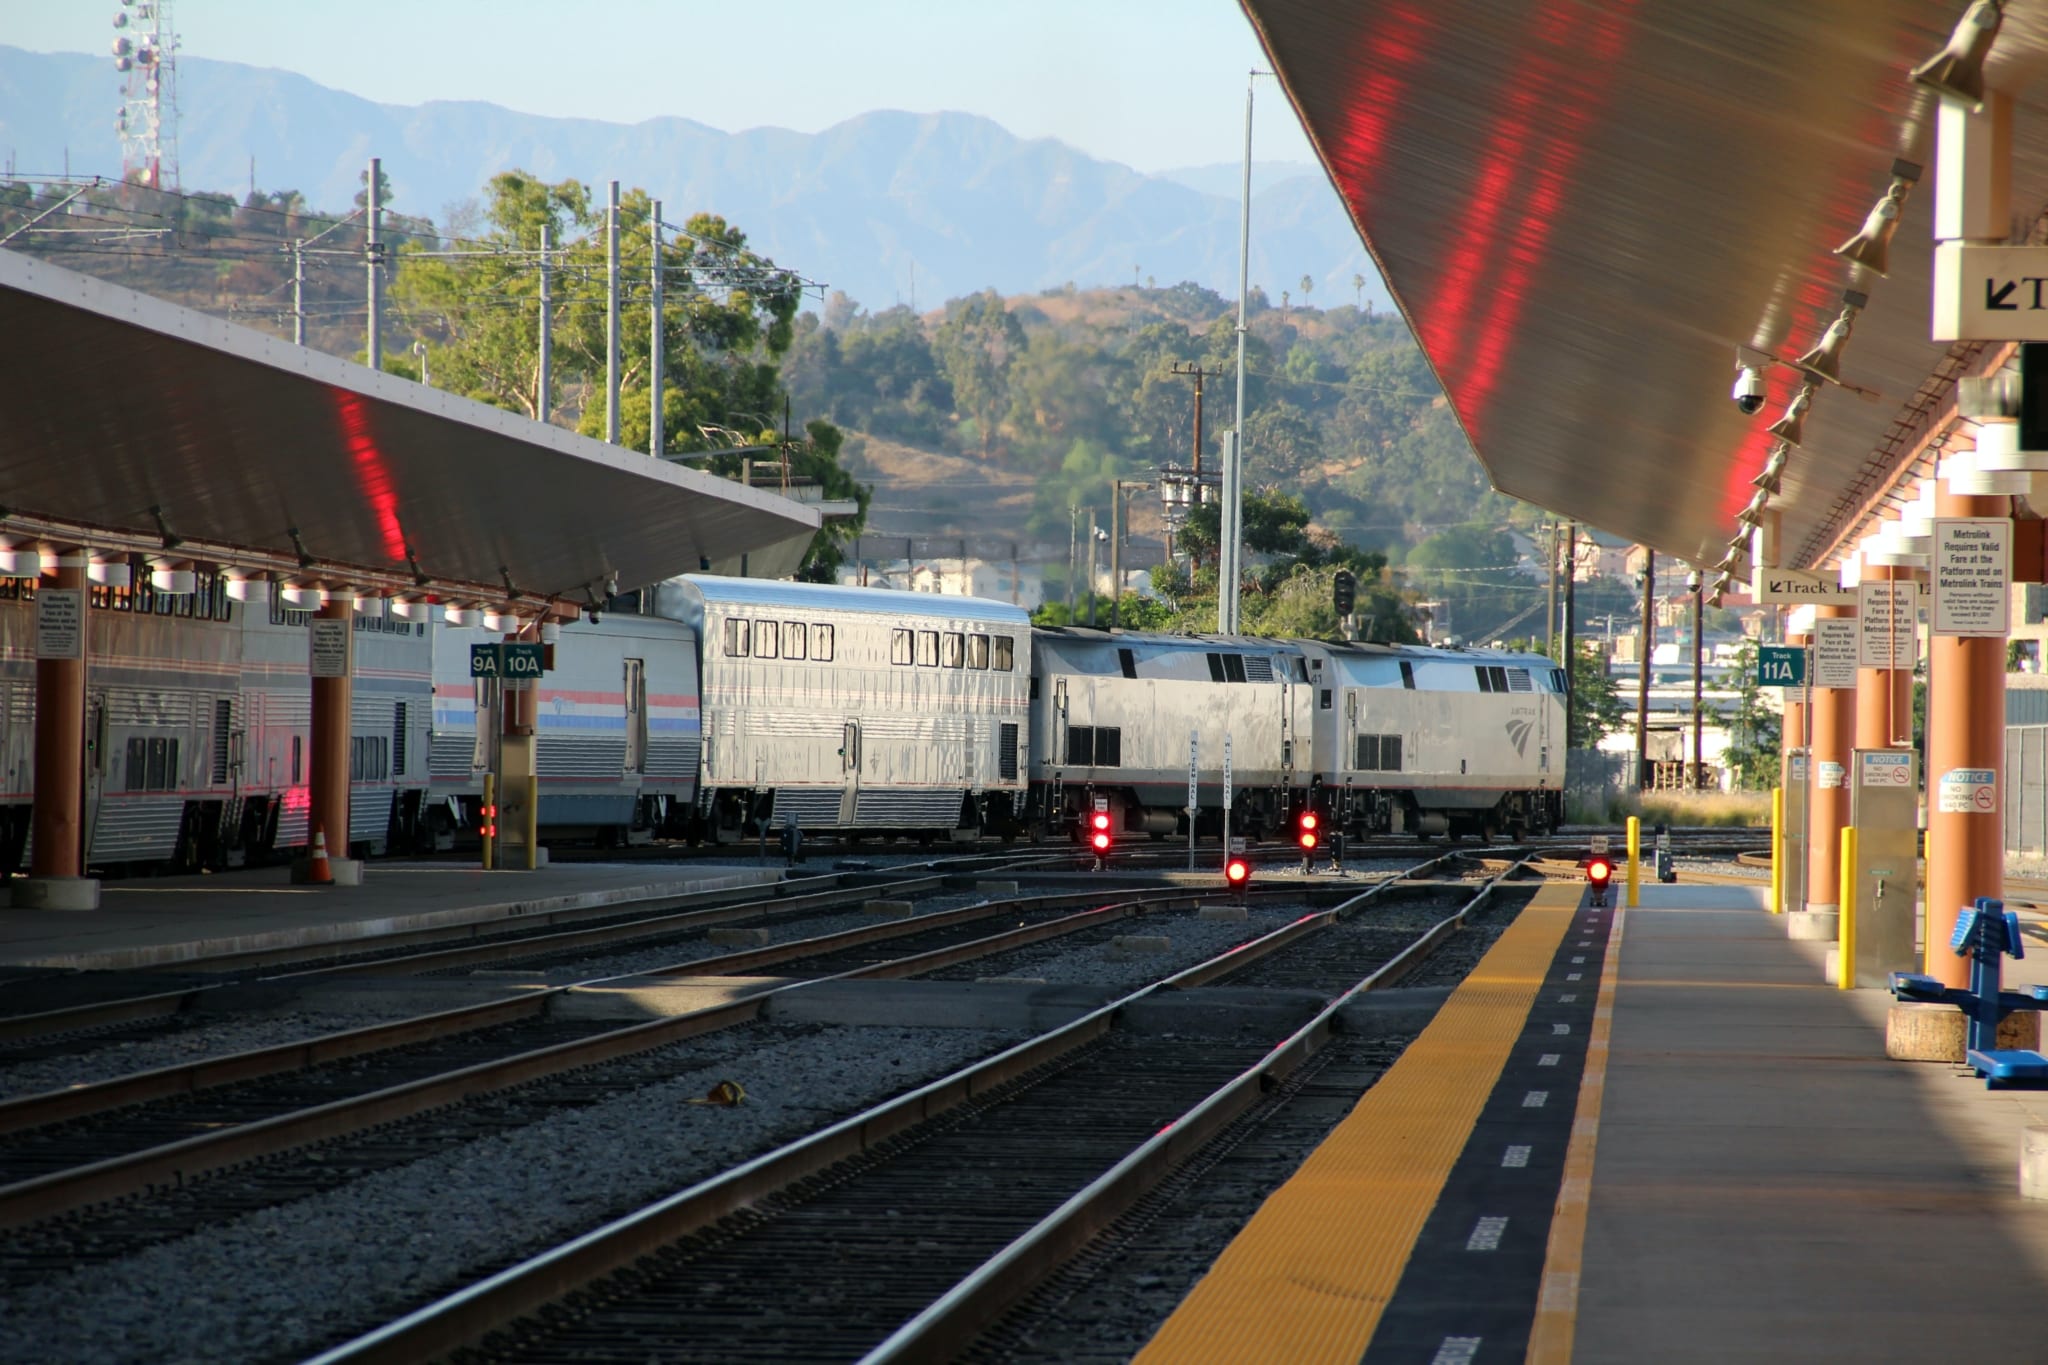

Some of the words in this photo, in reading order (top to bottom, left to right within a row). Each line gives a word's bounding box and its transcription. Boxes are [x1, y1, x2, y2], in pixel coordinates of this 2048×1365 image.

[1953, 530, 1990, 539] Metrolink
[1944, 542, 1978, 552] Requires
[1981, 543, 2000, 551] Valid
[1950, 554, 1967, 563] Fare
[1969, 555, 1978, 563] at
[1980, 555, 1993, 563] the
[1940, 566, 1974, 576] Platform
[1976, 567, 1990, 576] and
[1993, 568, 2003, 576] on
[1784, 580, 1827, 594] Track
[1940, 579, 1977, 588] Metrolink
[1979, 579, 2003, 588] Trains
[473, 656, 496, 672] 9A
[507, 656, 539, 672] 10A
[1763, 661, 1793, 680] 11A
[1872, 755, 1902, 764] NOTICE
[1949, 773, 1989, 782] NOTICE
